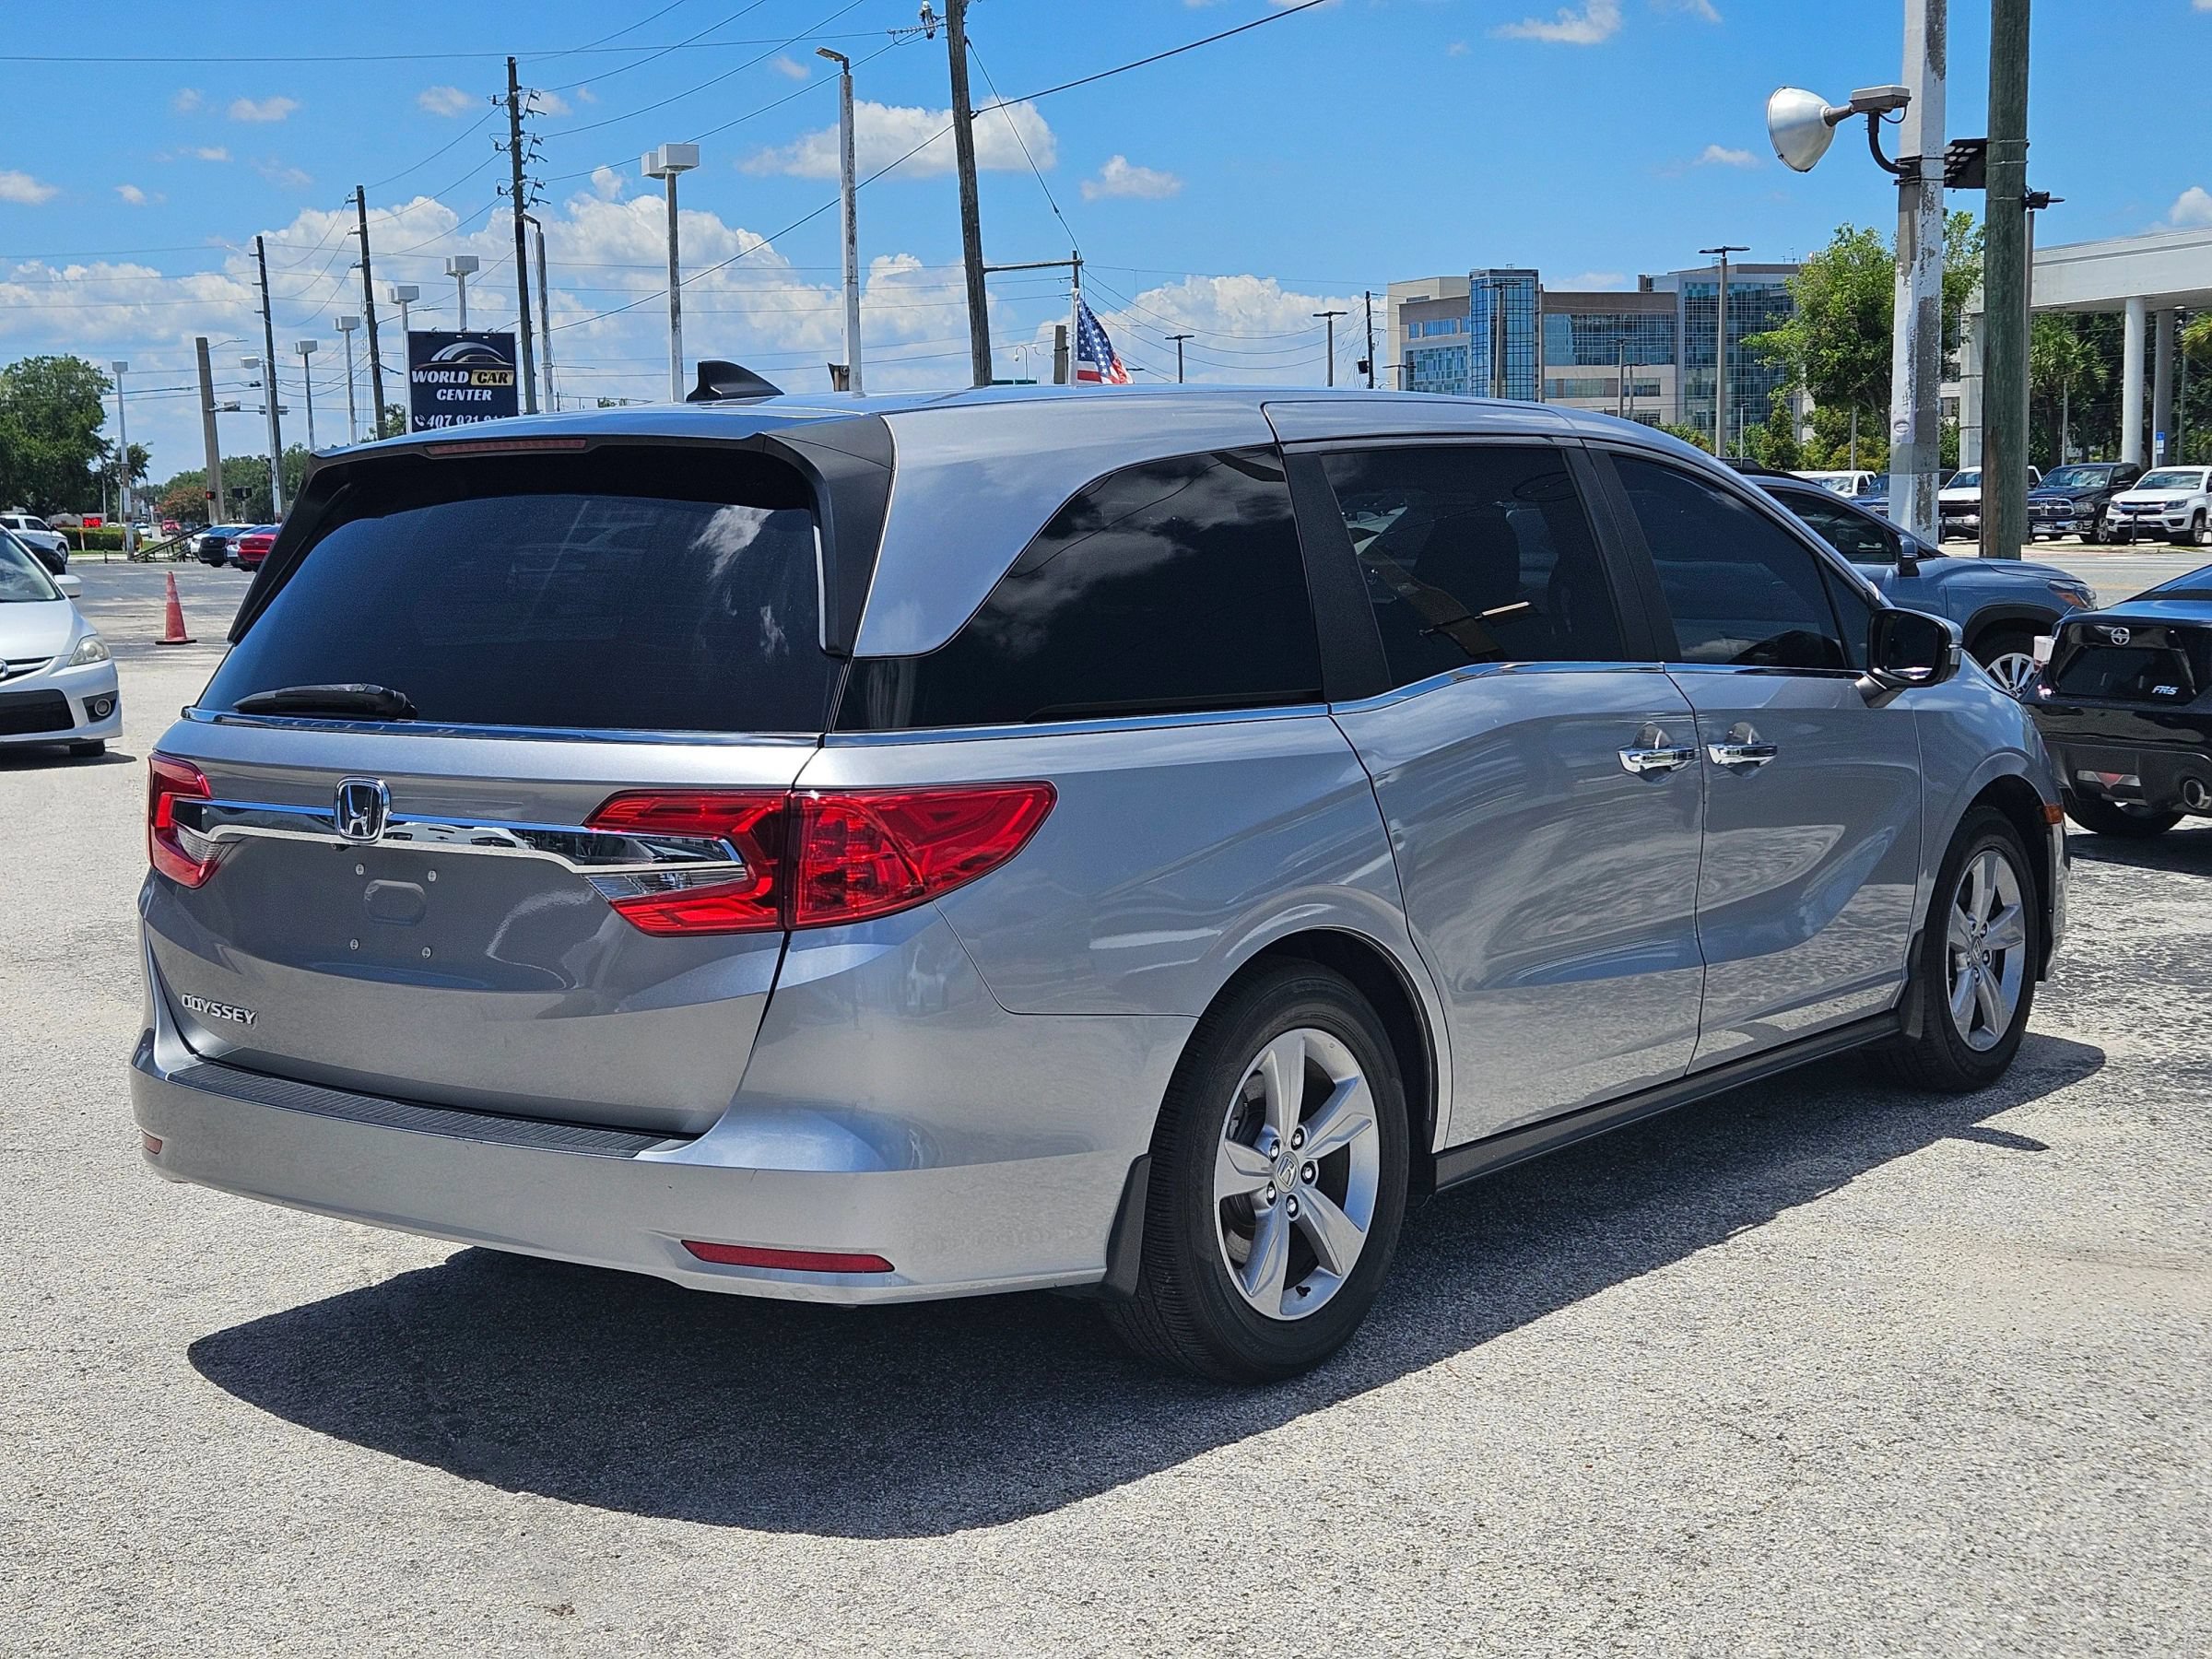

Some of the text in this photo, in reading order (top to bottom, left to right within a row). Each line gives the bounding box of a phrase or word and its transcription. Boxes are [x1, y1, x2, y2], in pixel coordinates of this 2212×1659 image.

[411, 371, 509, 383] WORLD CAR
[436, 389, 492, 401] CENTER
[427, 415, 452, 429] 407
[182, 994, 258, 1025] ODYSSEY
